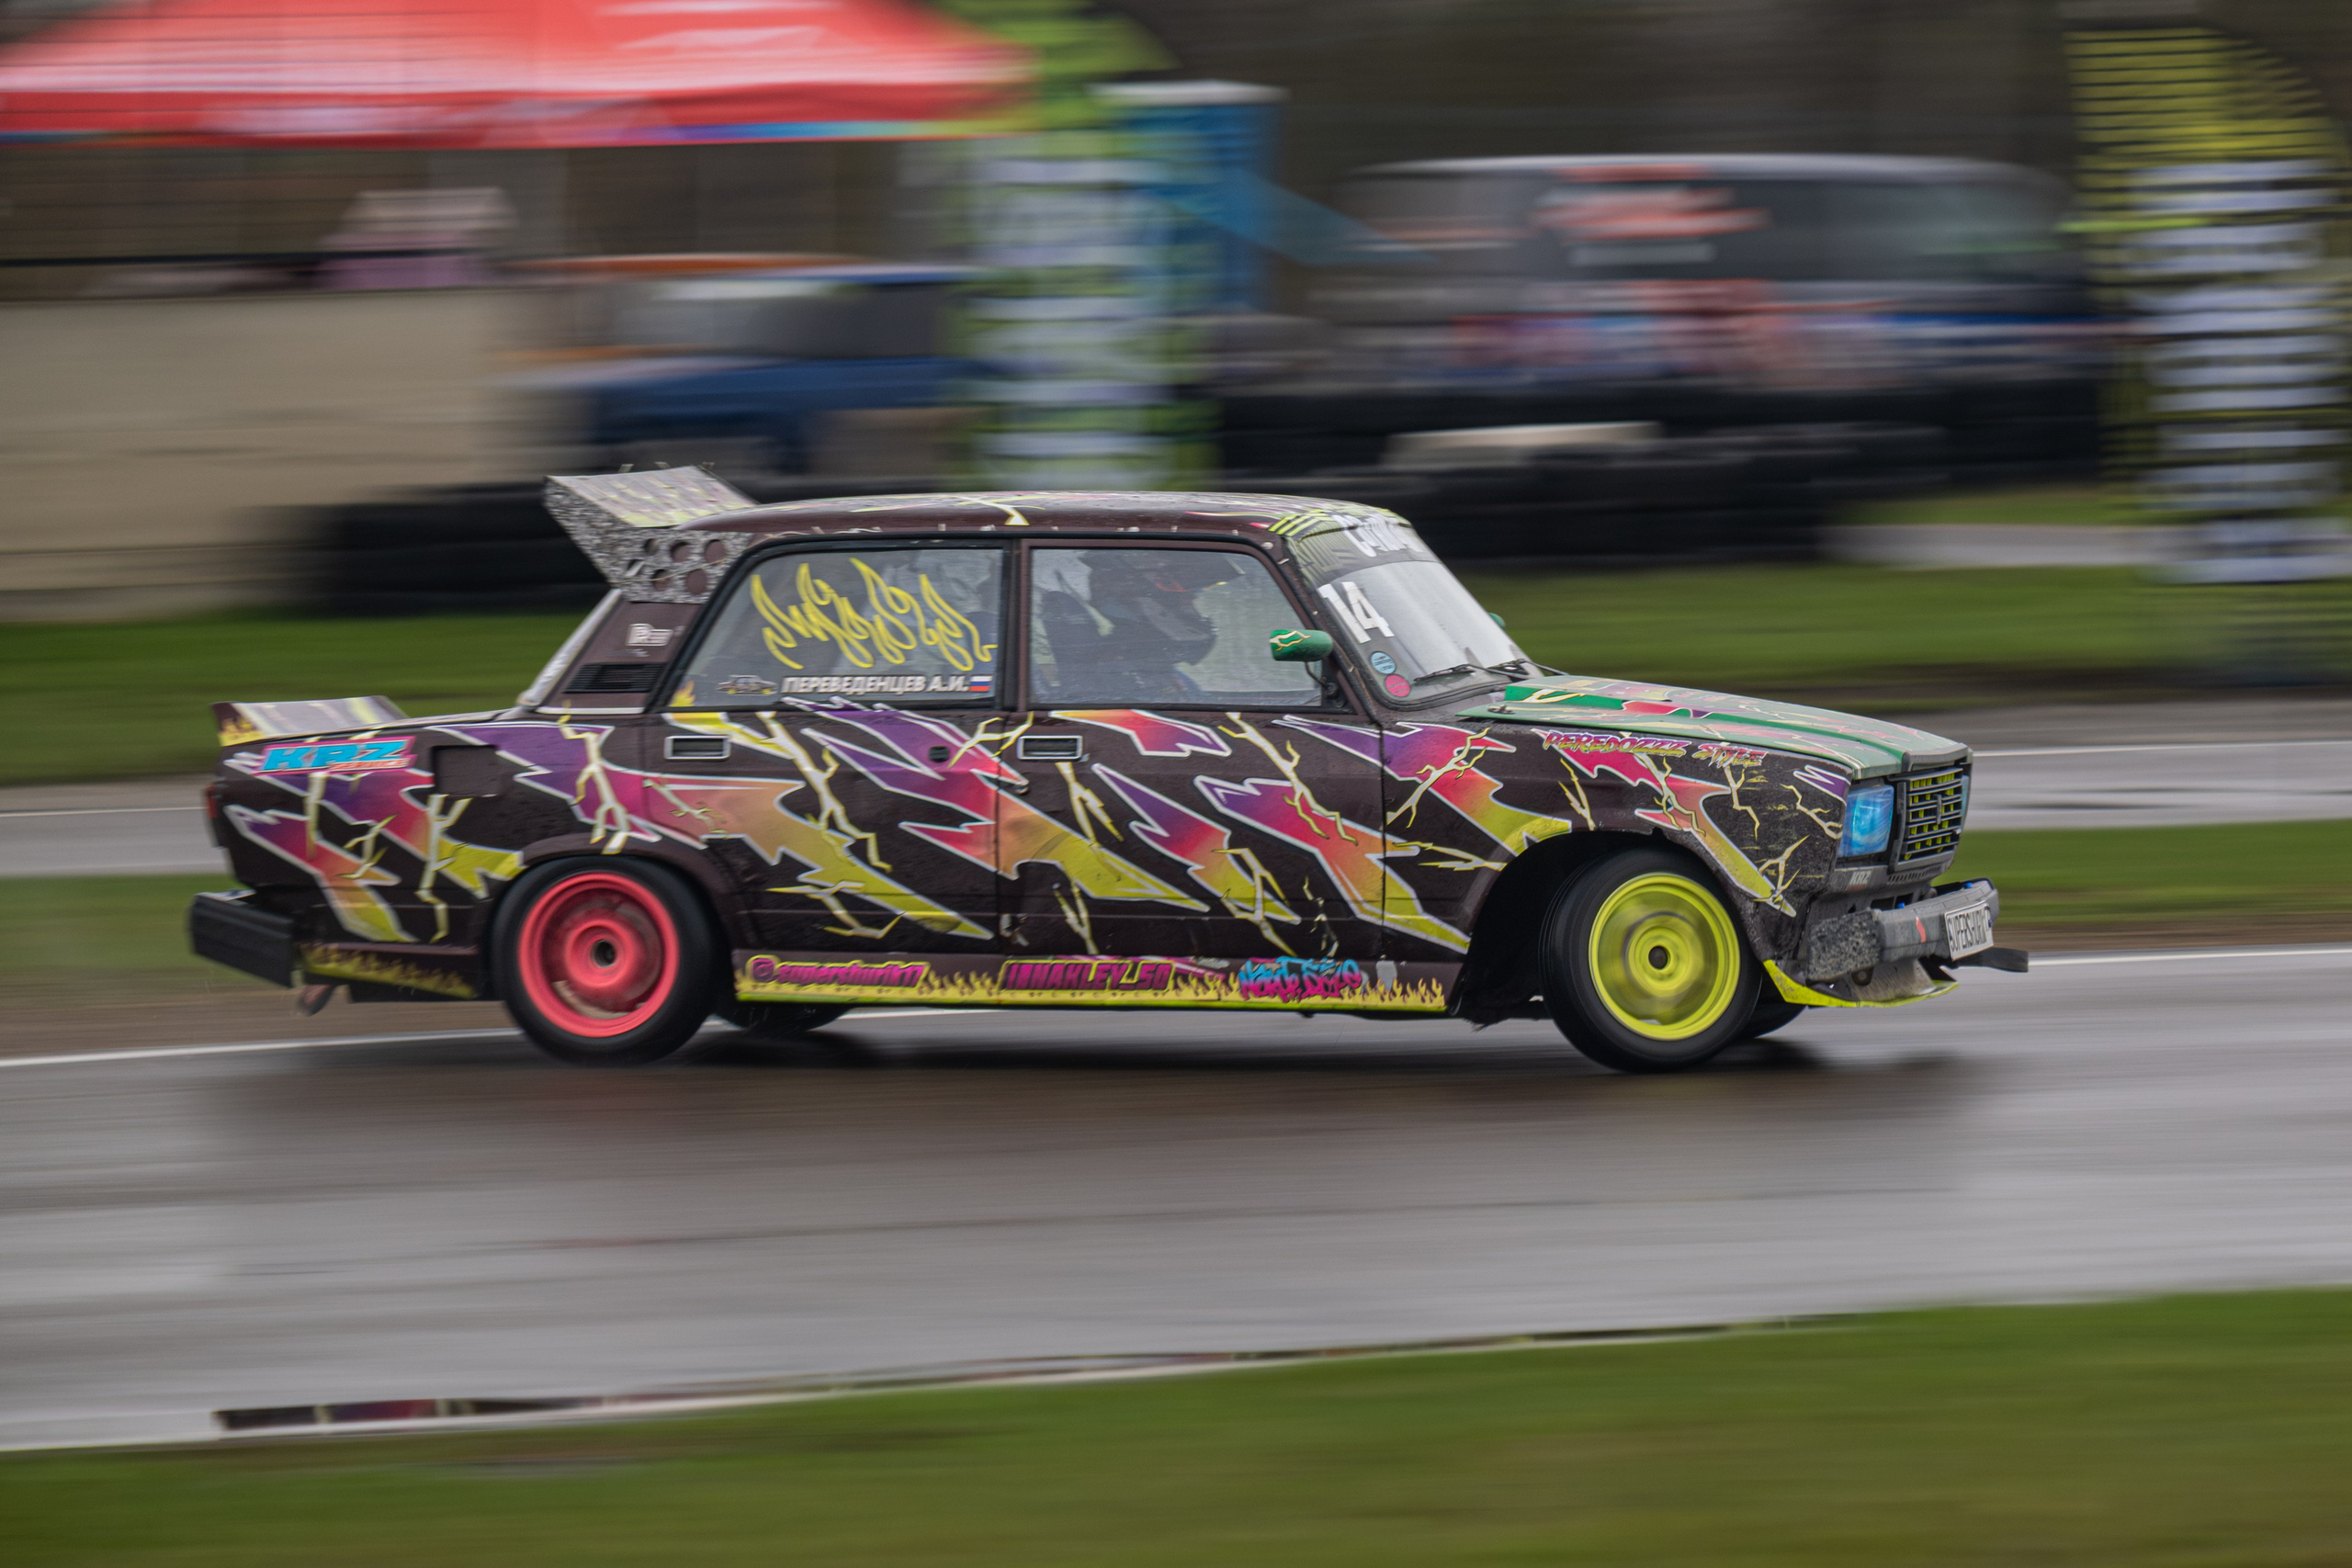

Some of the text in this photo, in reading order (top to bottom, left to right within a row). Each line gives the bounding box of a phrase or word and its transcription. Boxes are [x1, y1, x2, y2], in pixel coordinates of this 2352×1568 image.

[1317, 581, 1395, 643] 14
[783, 675, 925, 695] ПЕРЕВЕДЕНЦЕВ
[262, 739, 407, 771] KRZ
